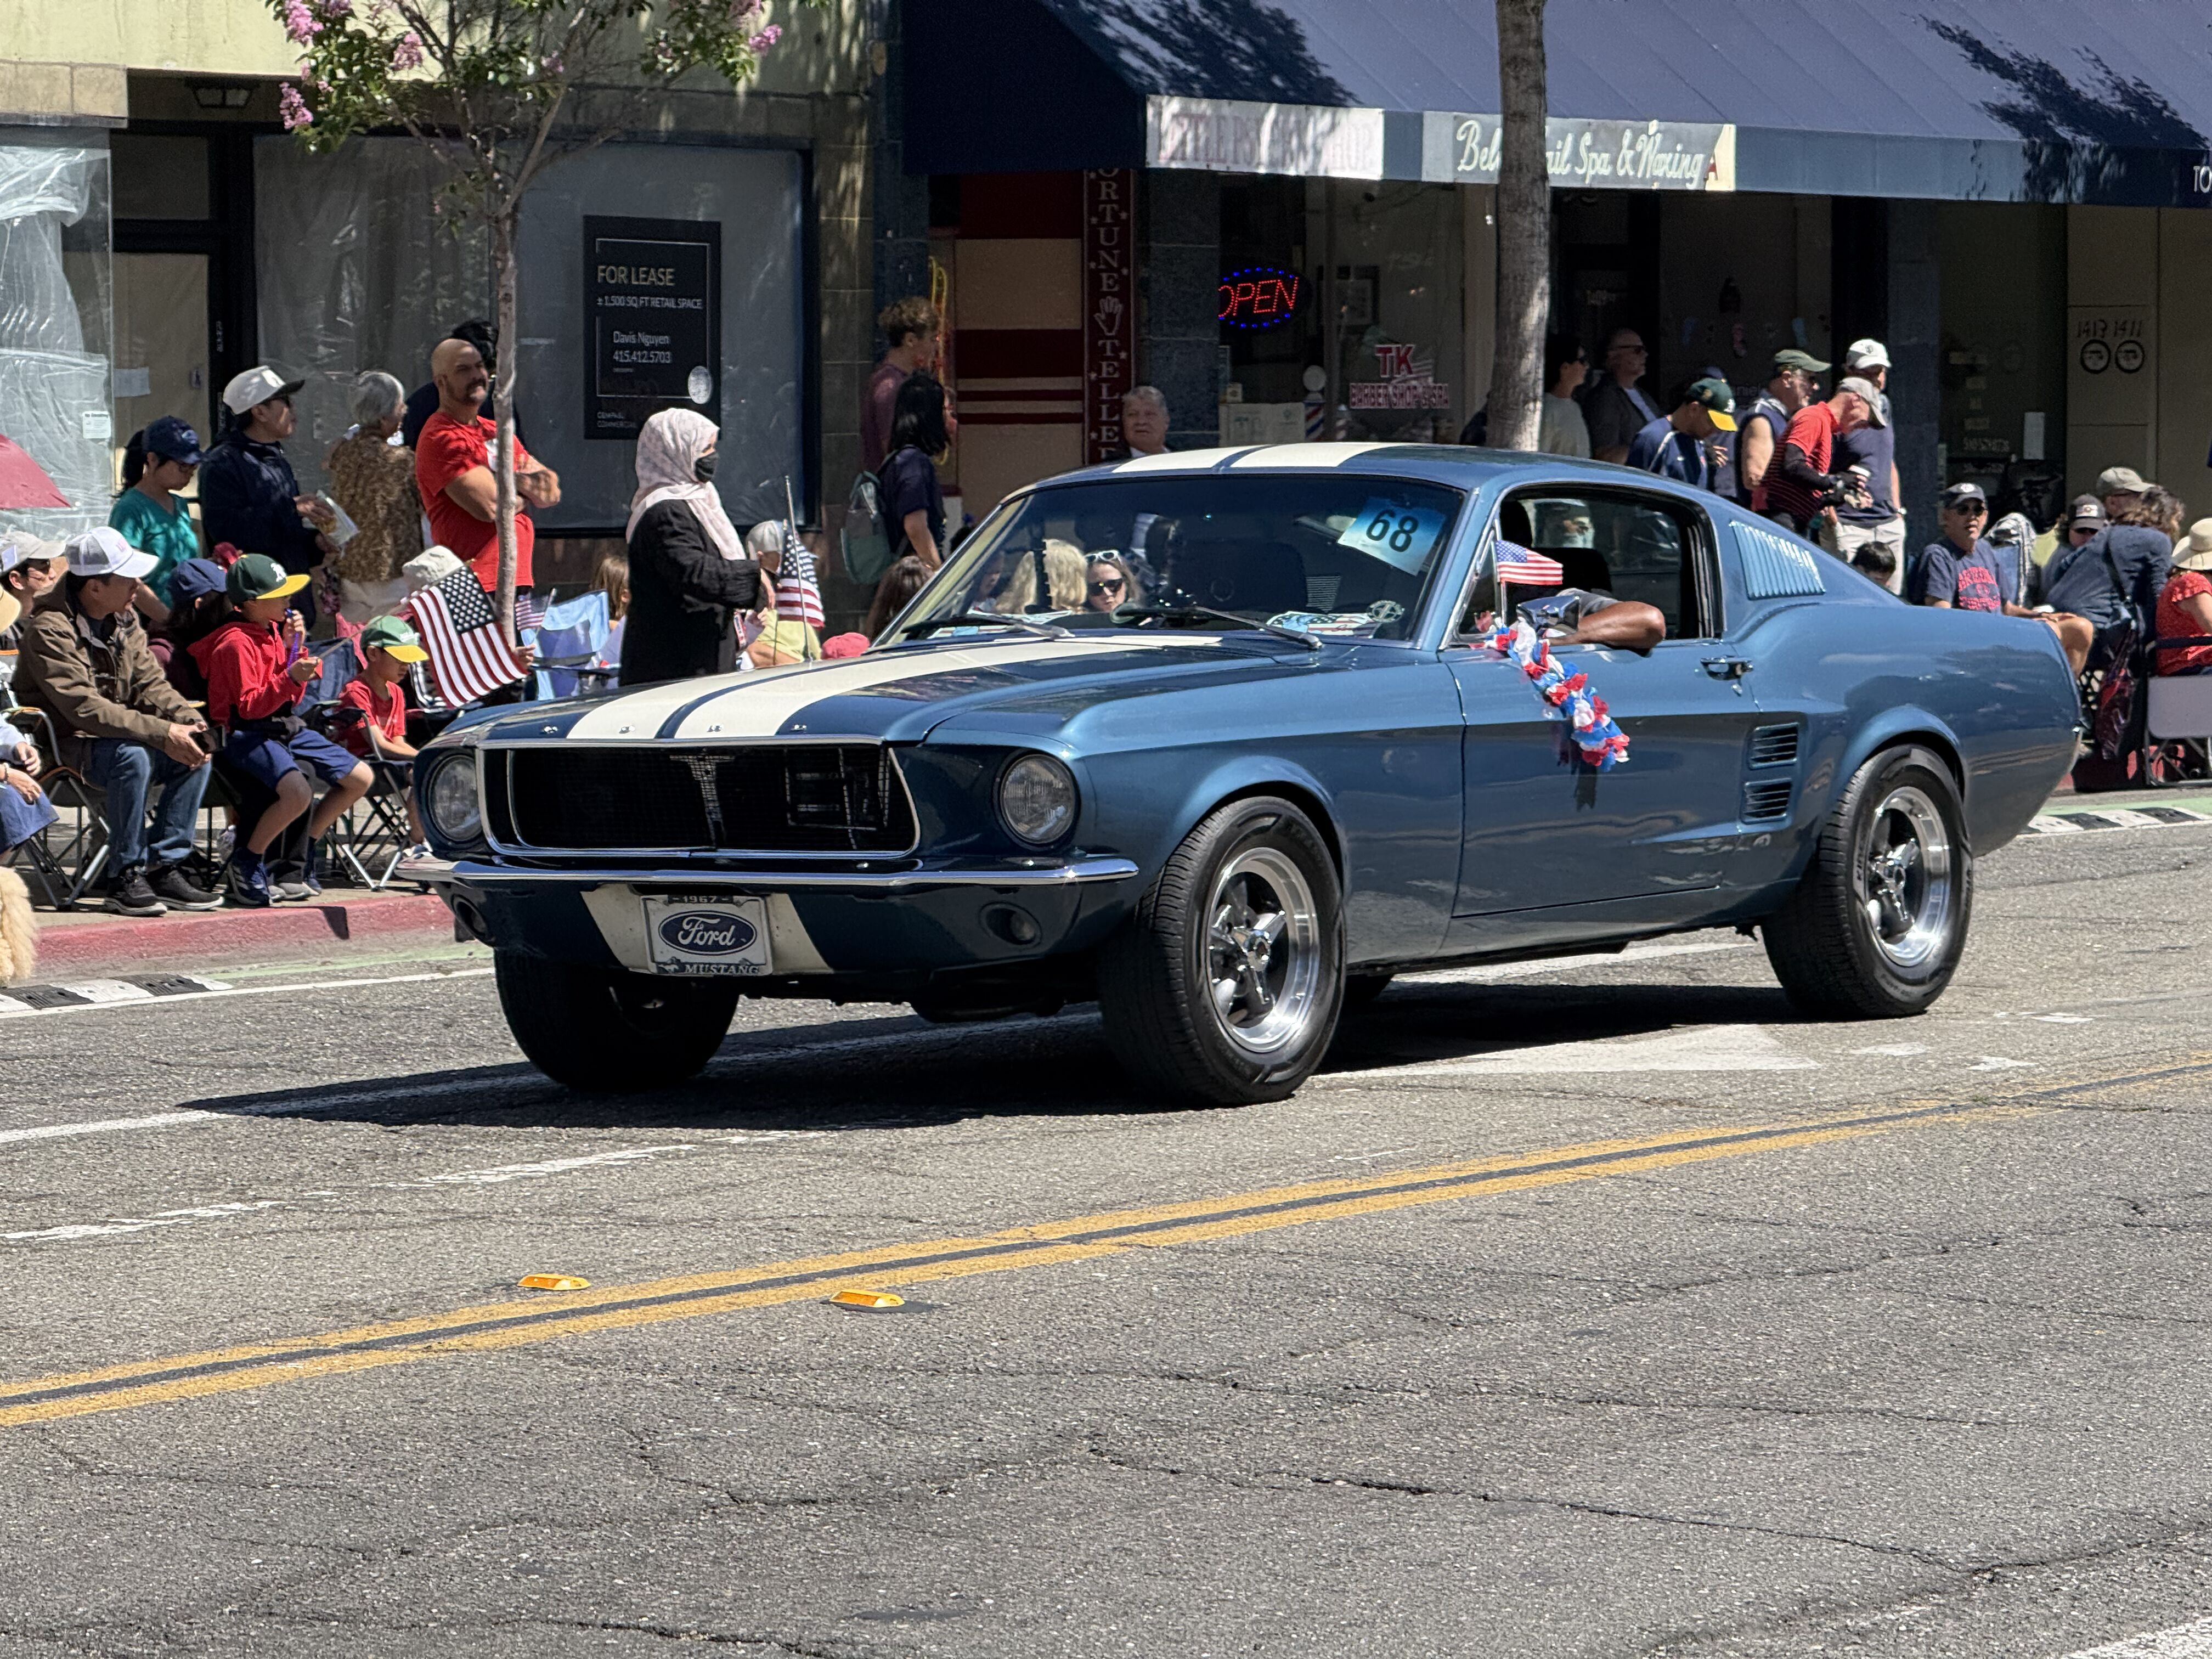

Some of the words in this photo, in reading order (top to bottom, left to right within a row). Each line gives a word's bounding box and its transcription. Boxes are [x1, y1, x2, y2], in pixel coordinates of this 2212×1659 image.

[1457, 120, 1502, 172] Bel
[1575, 132, 1611, 184] Spa
[1616, 129, 1635, 177] &
[1635, 132, 1706, 189] Waxing
[596, 266, 629, 284] FOR
[630, 267, 675, 286] LEASE
[626, 296, 639, 308] SQ
[639, 296, 650, 307] FT
[650, 297, 676, 308] RETAIL
[677, 298, 703, 309] SPACE
[613, 331, 636, 345] Davis
[638, 332, 670, 347] Nguyen
[1375, 344, 1416, 378] TK
[1365, 509, 1420, 553] 68
[678, 916, 736, 946] Ford
[685, 963, 760, 975] MUSTANG
